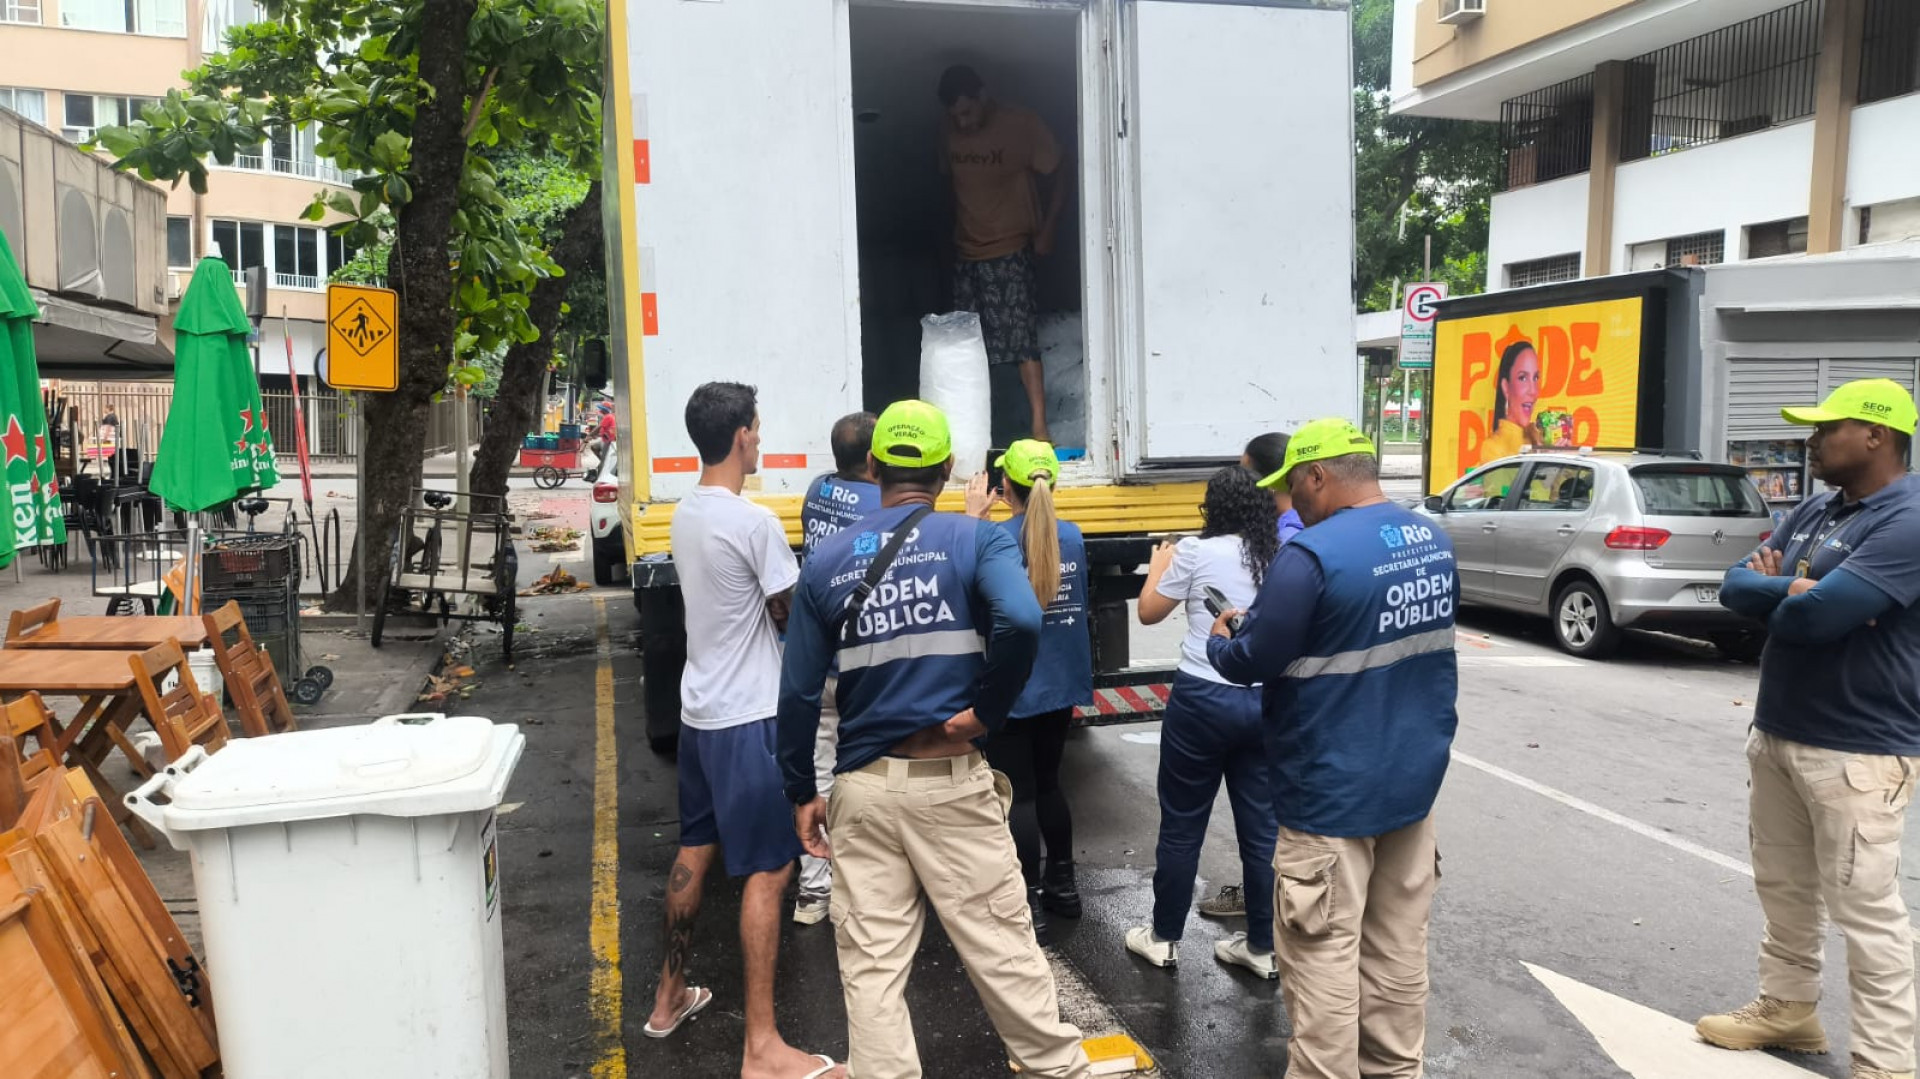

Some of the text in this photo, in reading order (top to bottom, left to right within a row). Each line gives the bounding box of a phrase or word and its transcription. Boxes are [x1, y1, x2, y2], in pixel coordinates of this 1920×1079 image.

[1862, 401, 1892, 414] SEOP
[1296, 444, 1321, 456] SEOP
[831, 485, 860, 505] Rio
[808, 518, 846, 536] ORD
[1400, 523, 1433, 546] Rio
[1372, 558, 1420, 577] SECRETARIA
[1416, 566, 1427, 577] DE
[830, 568, 868, 588] SECRET
[1386, 570, 1454, 607] ORDEM
